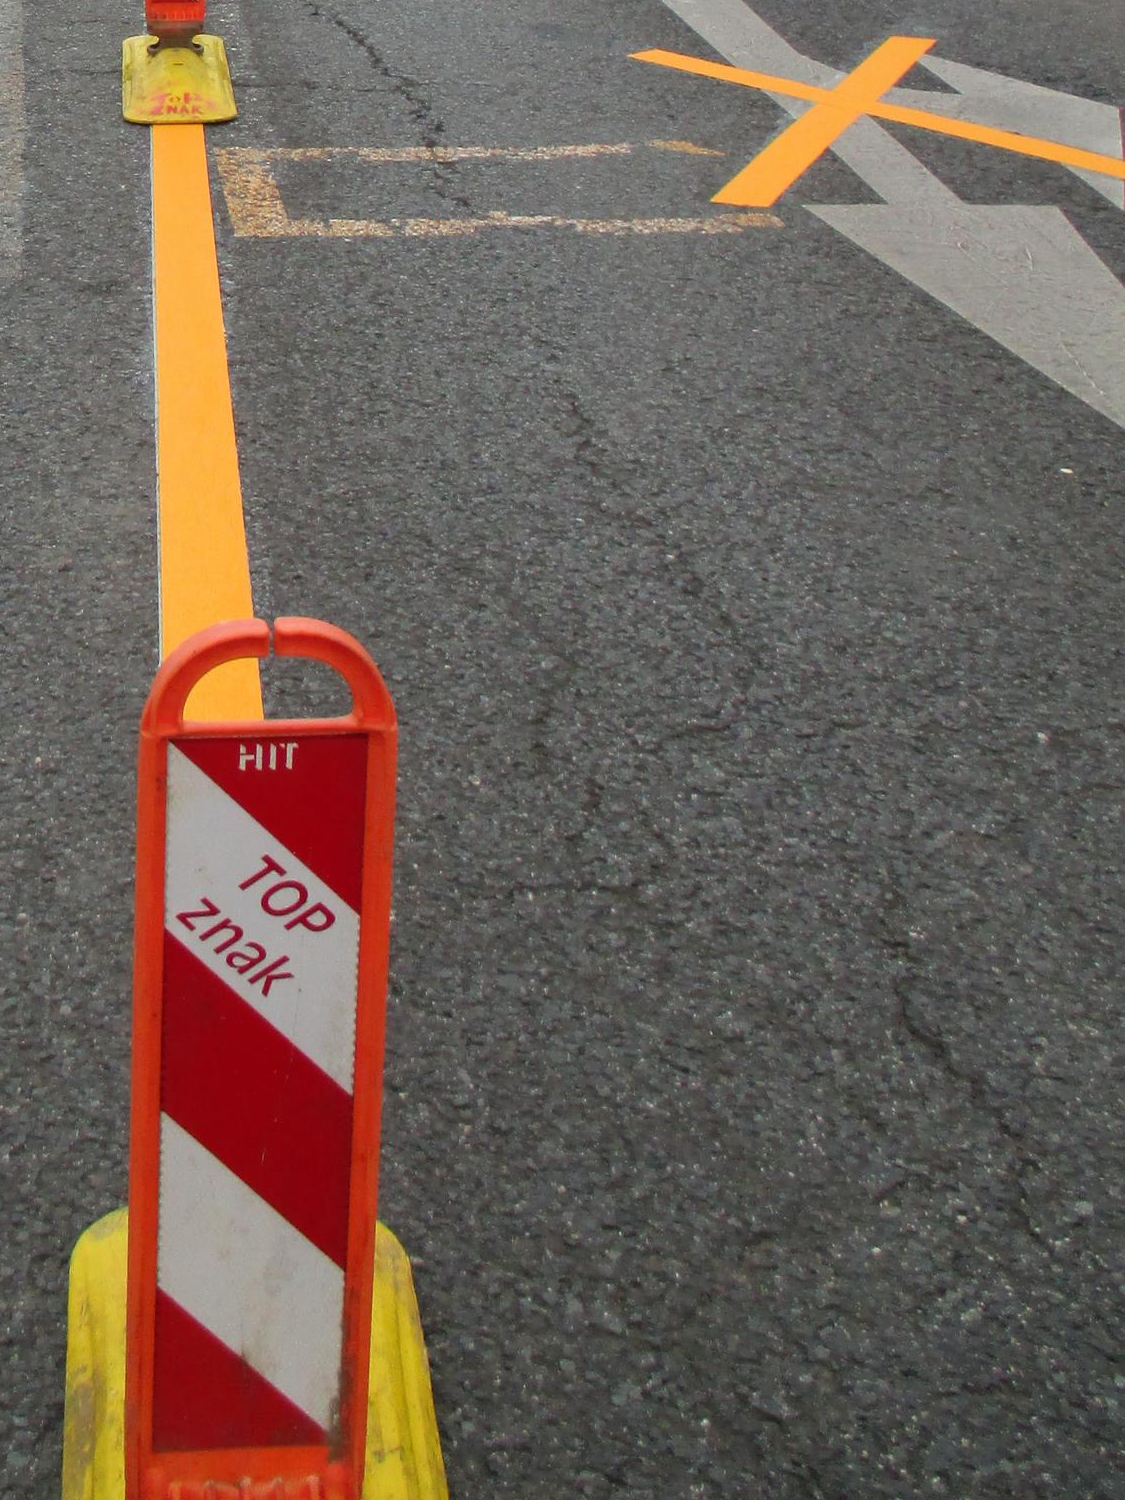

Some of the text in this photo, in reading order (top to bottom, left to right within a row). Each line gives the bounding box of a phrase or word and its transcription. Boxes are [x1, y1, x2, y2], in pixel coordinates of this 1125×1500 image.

[238, 741, 299, 771] HIT
[238, 853, 336, 933] TOP
[175, 895, 295, 998] znak
